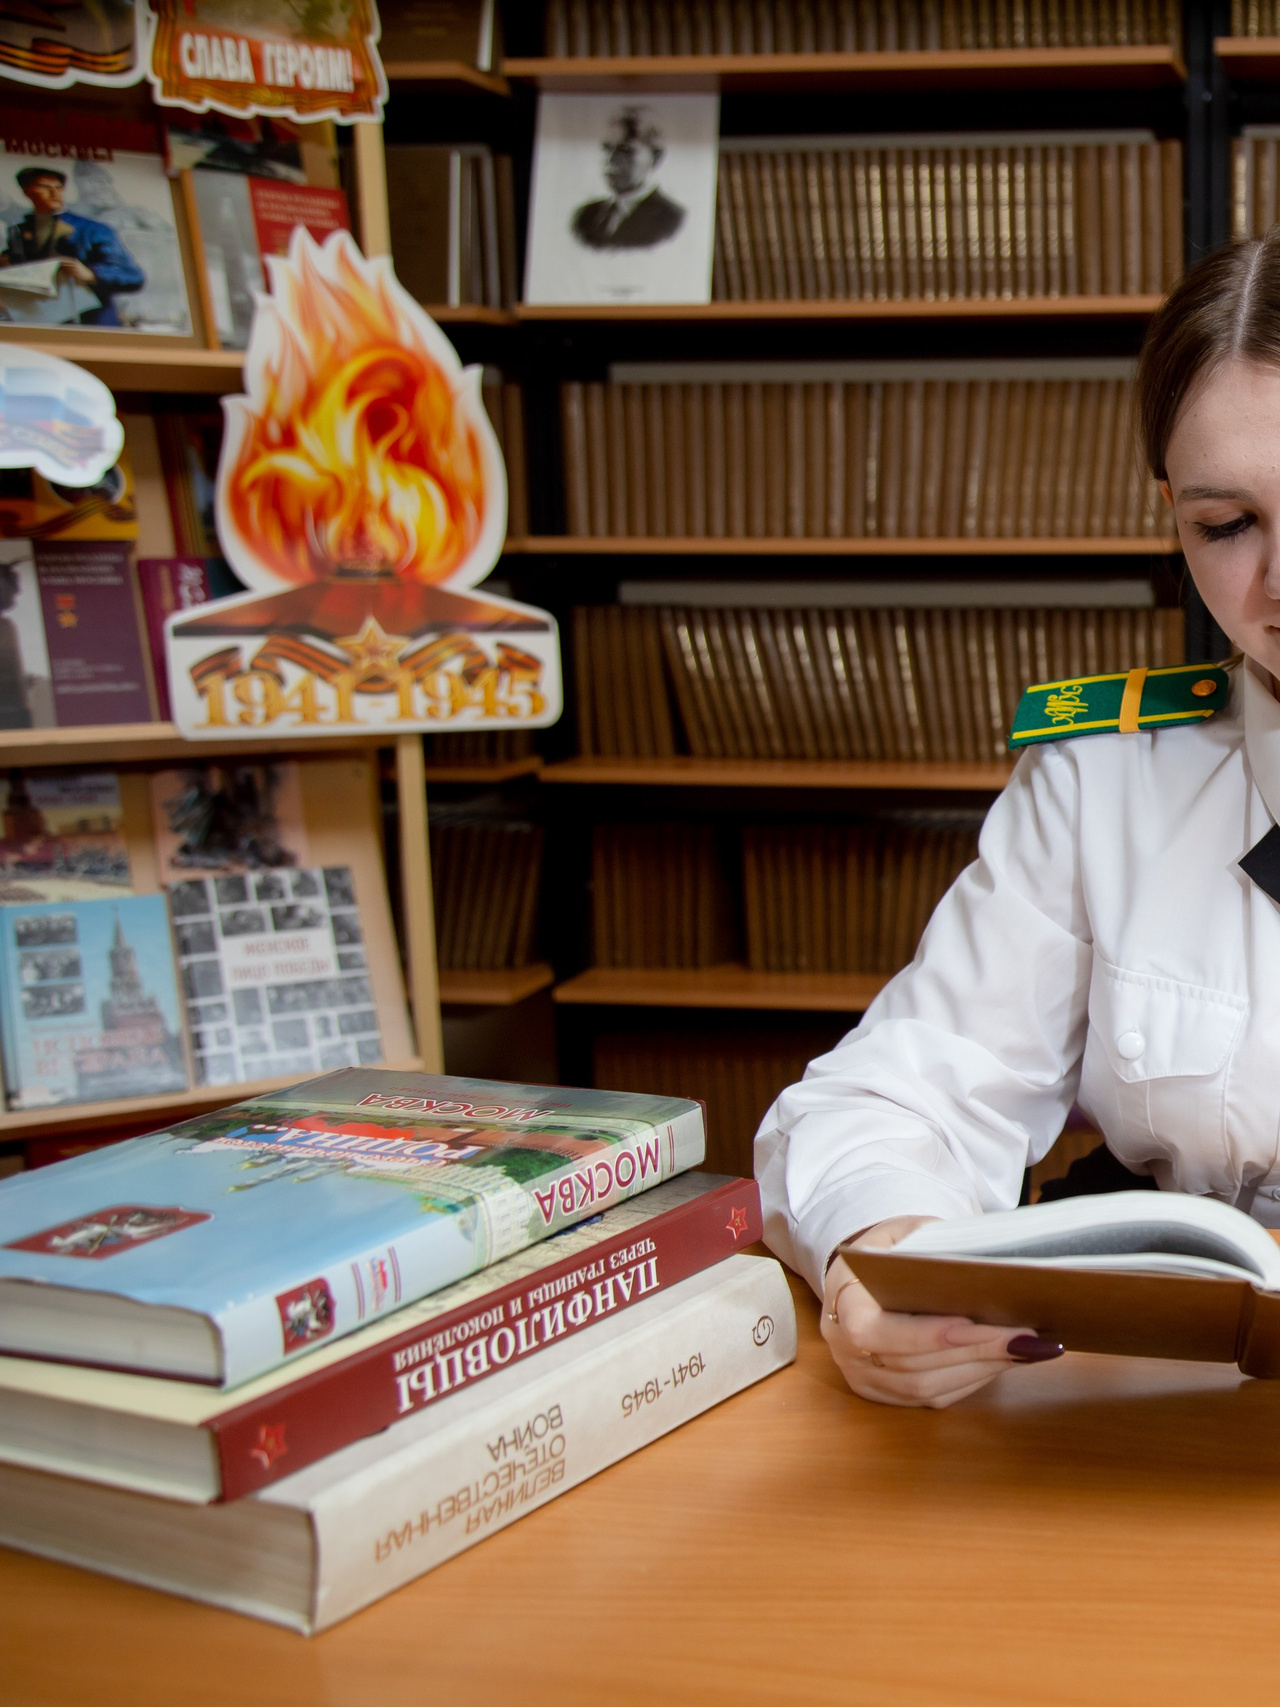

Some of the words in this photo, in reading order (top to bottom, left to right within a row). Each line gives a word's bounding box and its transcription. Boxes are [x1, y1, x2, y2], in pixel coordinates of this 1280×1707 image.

[180, 32, 256, 84] СЛАВА
[263, 42, 355, 93] ГЕРОЯМ!
[193, 668, 550, 729] 1941-1945
[355, 1092, 555, 1122] МОСКВА
[532, 1136, 660, 1226] МОСКВА
[527, 1258, 606, 1309] ГРАНИЦЫ
[610, 1238, 657, 1269] ЧЕРЕЗ
[394, 1256, 661, 1415] ПАНФИЛОВЦЫ
[509, 1296, 522, 1318] И
[393, 1304, 505, 1373] ПОКОЛЕНИЯ
[621, 1352, 707, 1419] 1941-1945
[486, 1403, 564, 1463] ВОЙНА
[374, 1433, 567, 1564] ОТЕЧЕСТВЕННАЯ
[465, 1458, 566, 1536] ВЕЛИКАЯ
